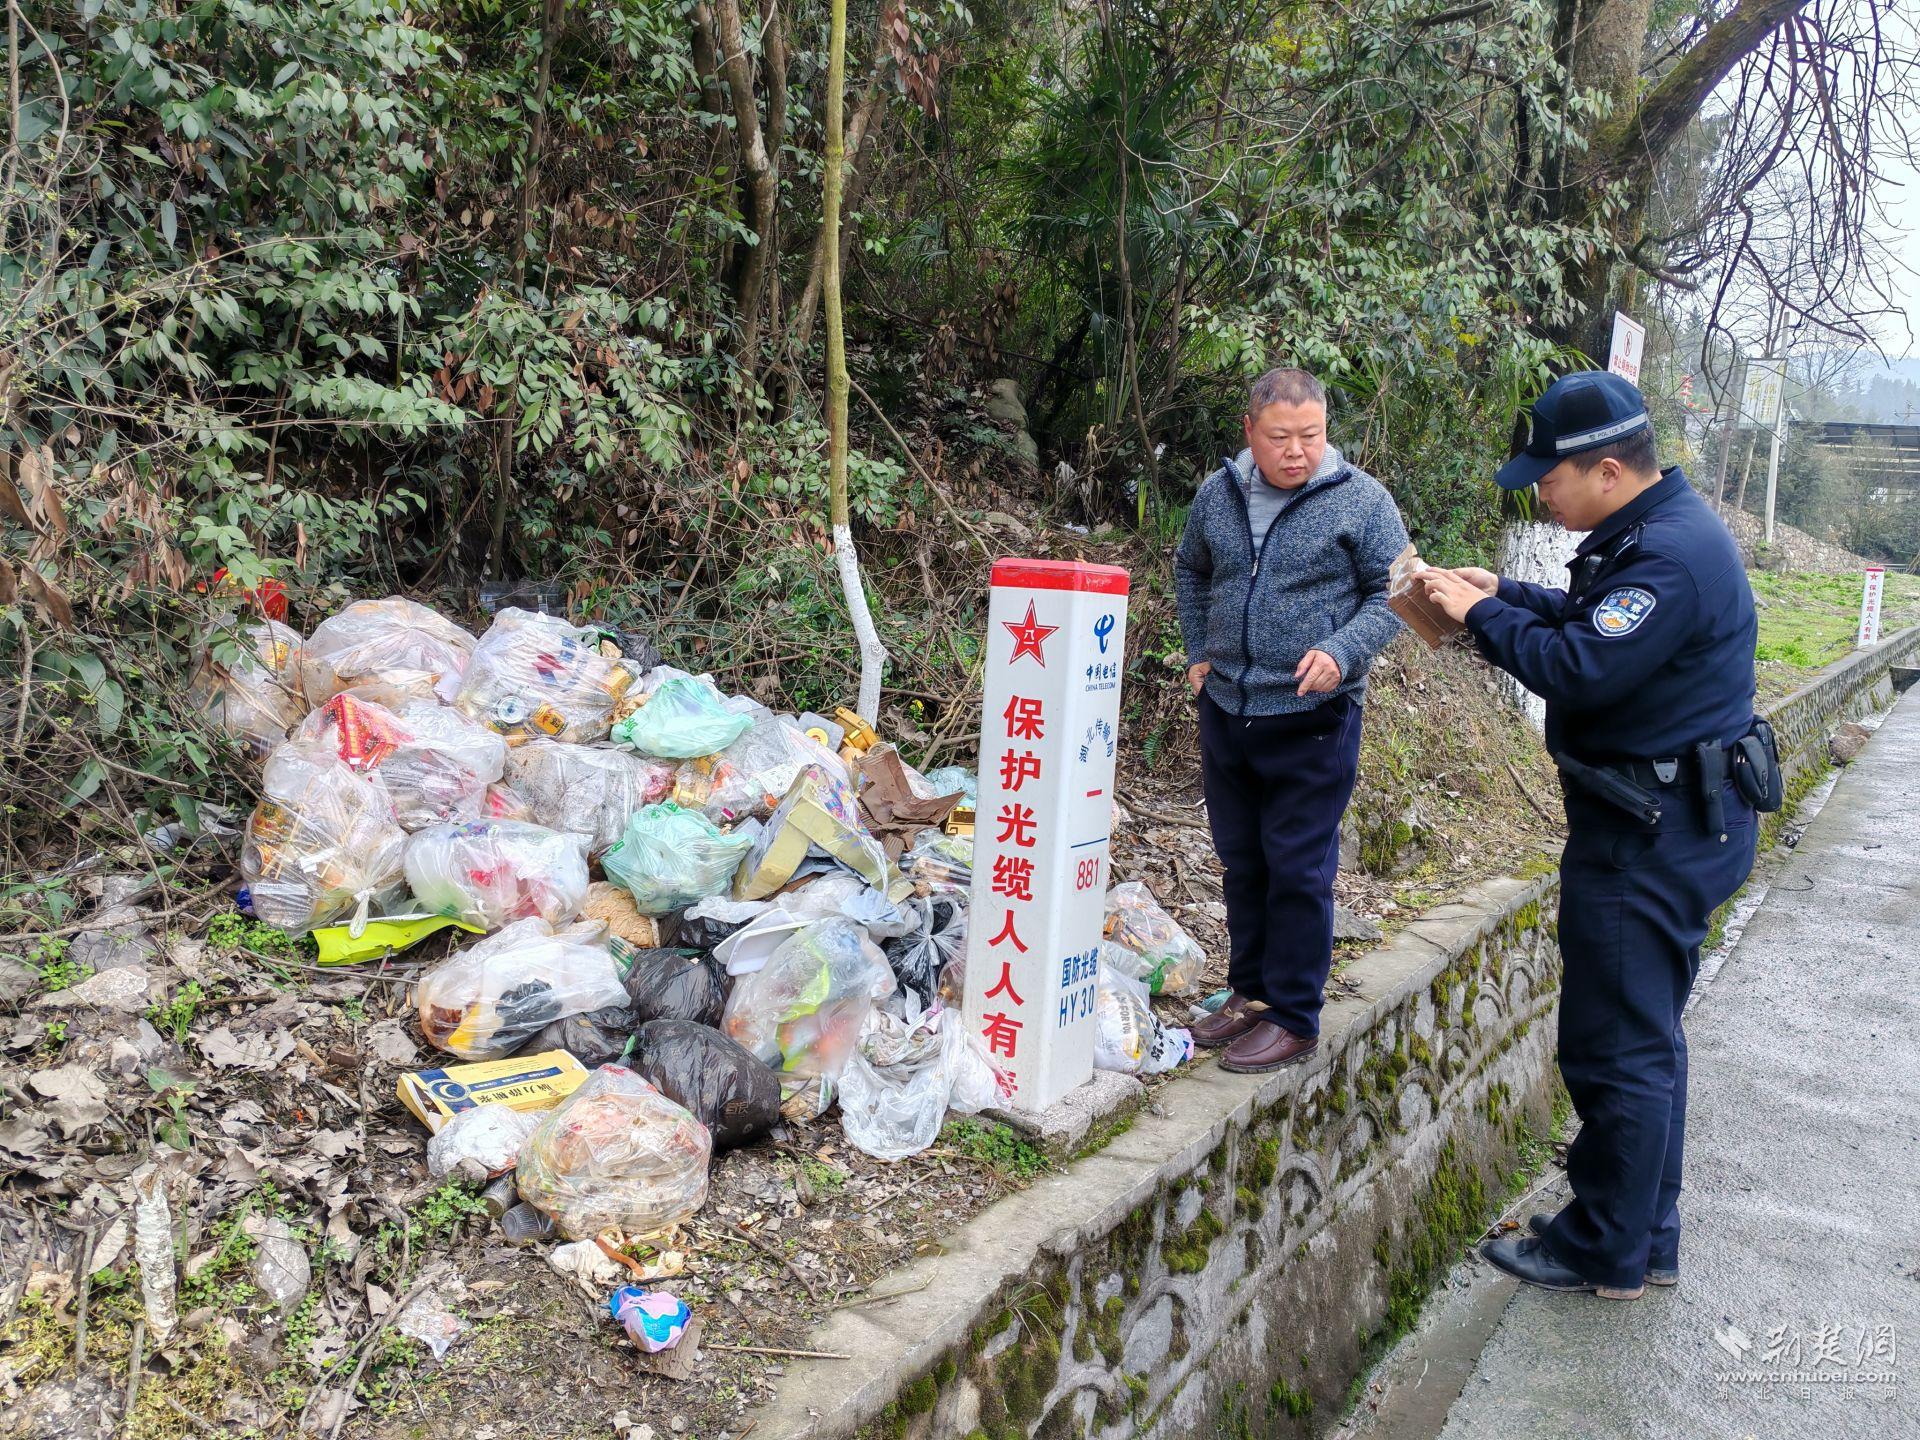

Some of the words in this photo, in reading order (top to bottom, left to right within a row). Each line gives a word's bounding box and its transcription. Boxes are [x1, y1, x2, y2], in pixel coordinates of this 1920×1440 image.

[1086, 662, 1116, 683] 中国电信
[1085, 684, 1098, 692] CHINA
[1098, 681, 1116, 690] TELECOM
[1076, 857, 1099, 891] 881
[1061, 946, 1099, 989] 国防光缆
